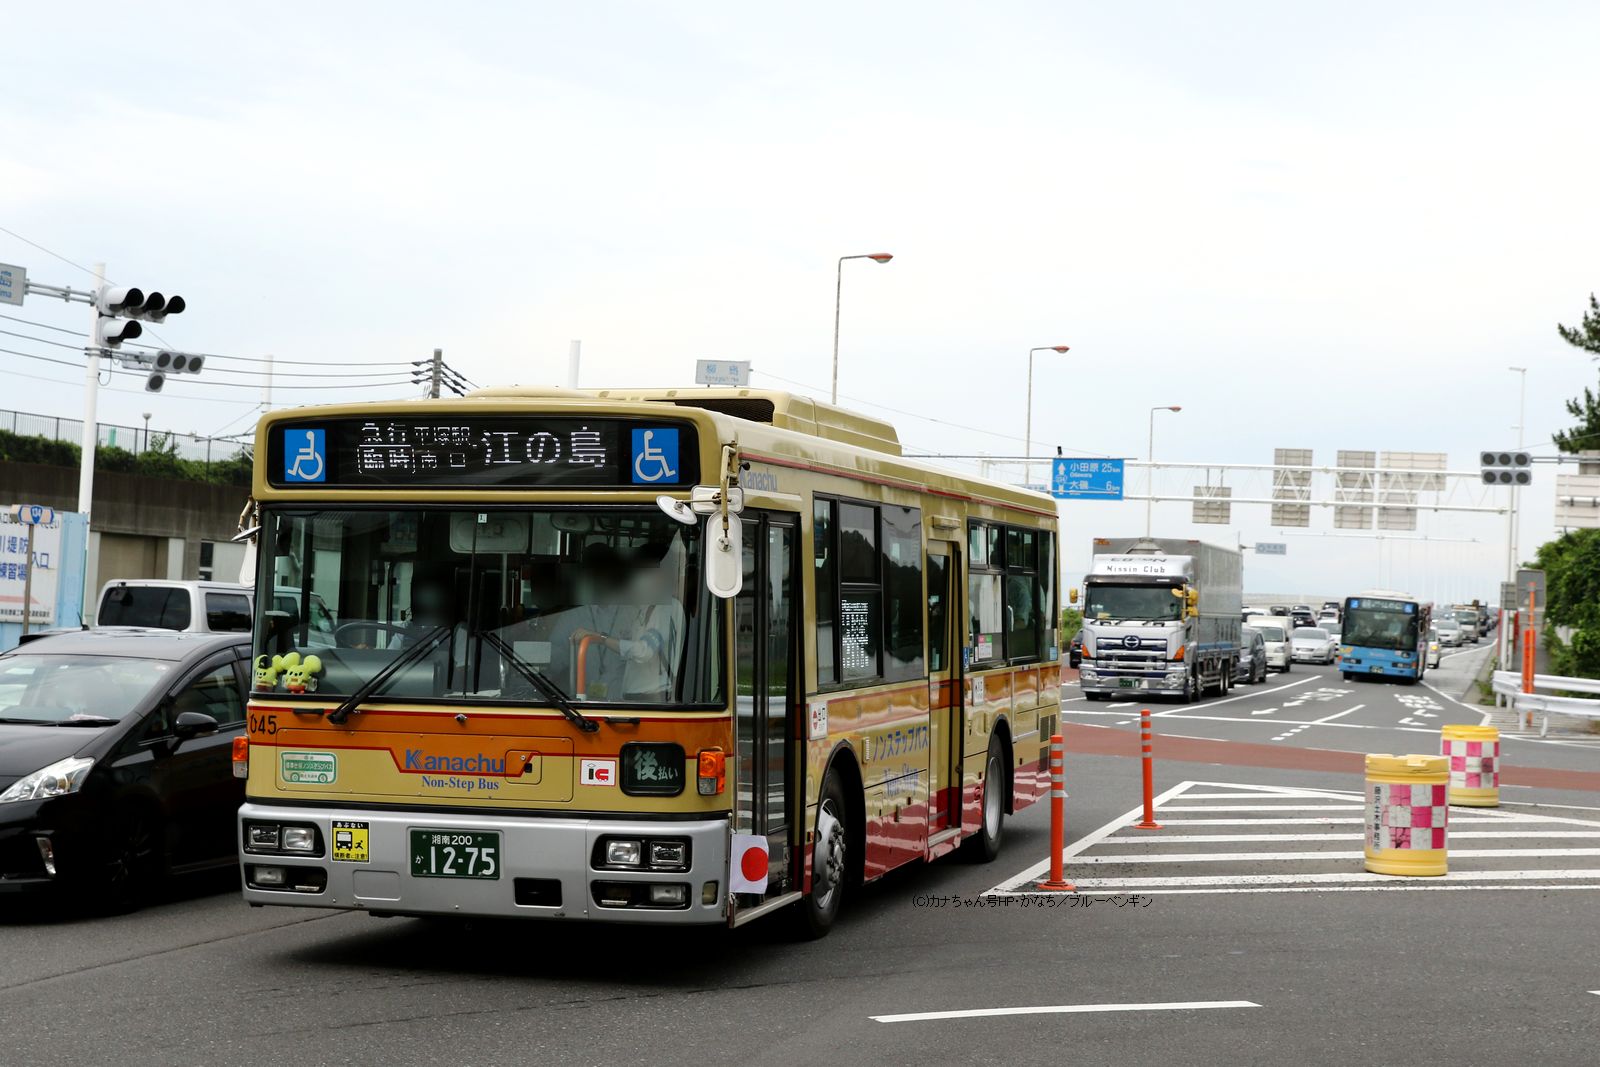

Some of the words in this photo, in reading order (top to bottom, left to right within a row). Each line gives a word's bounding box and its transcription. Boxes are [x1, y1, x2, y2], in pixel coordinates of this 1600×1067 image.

[481, 426, 606, 467] 江の島
[1070, 462, 1099, 473] 小田原
[1107, 565, 1138, 573] Nissin
[1143, 566, 1166, 574] Club
[405, 749, 505, 773] Kanachu
[634, 751, 679, 781] 後払い
[422, 775, 475, 792] Non-Step
[478, 778, 500, 791] Bus
[430, 846, 496, 876] 12-75
